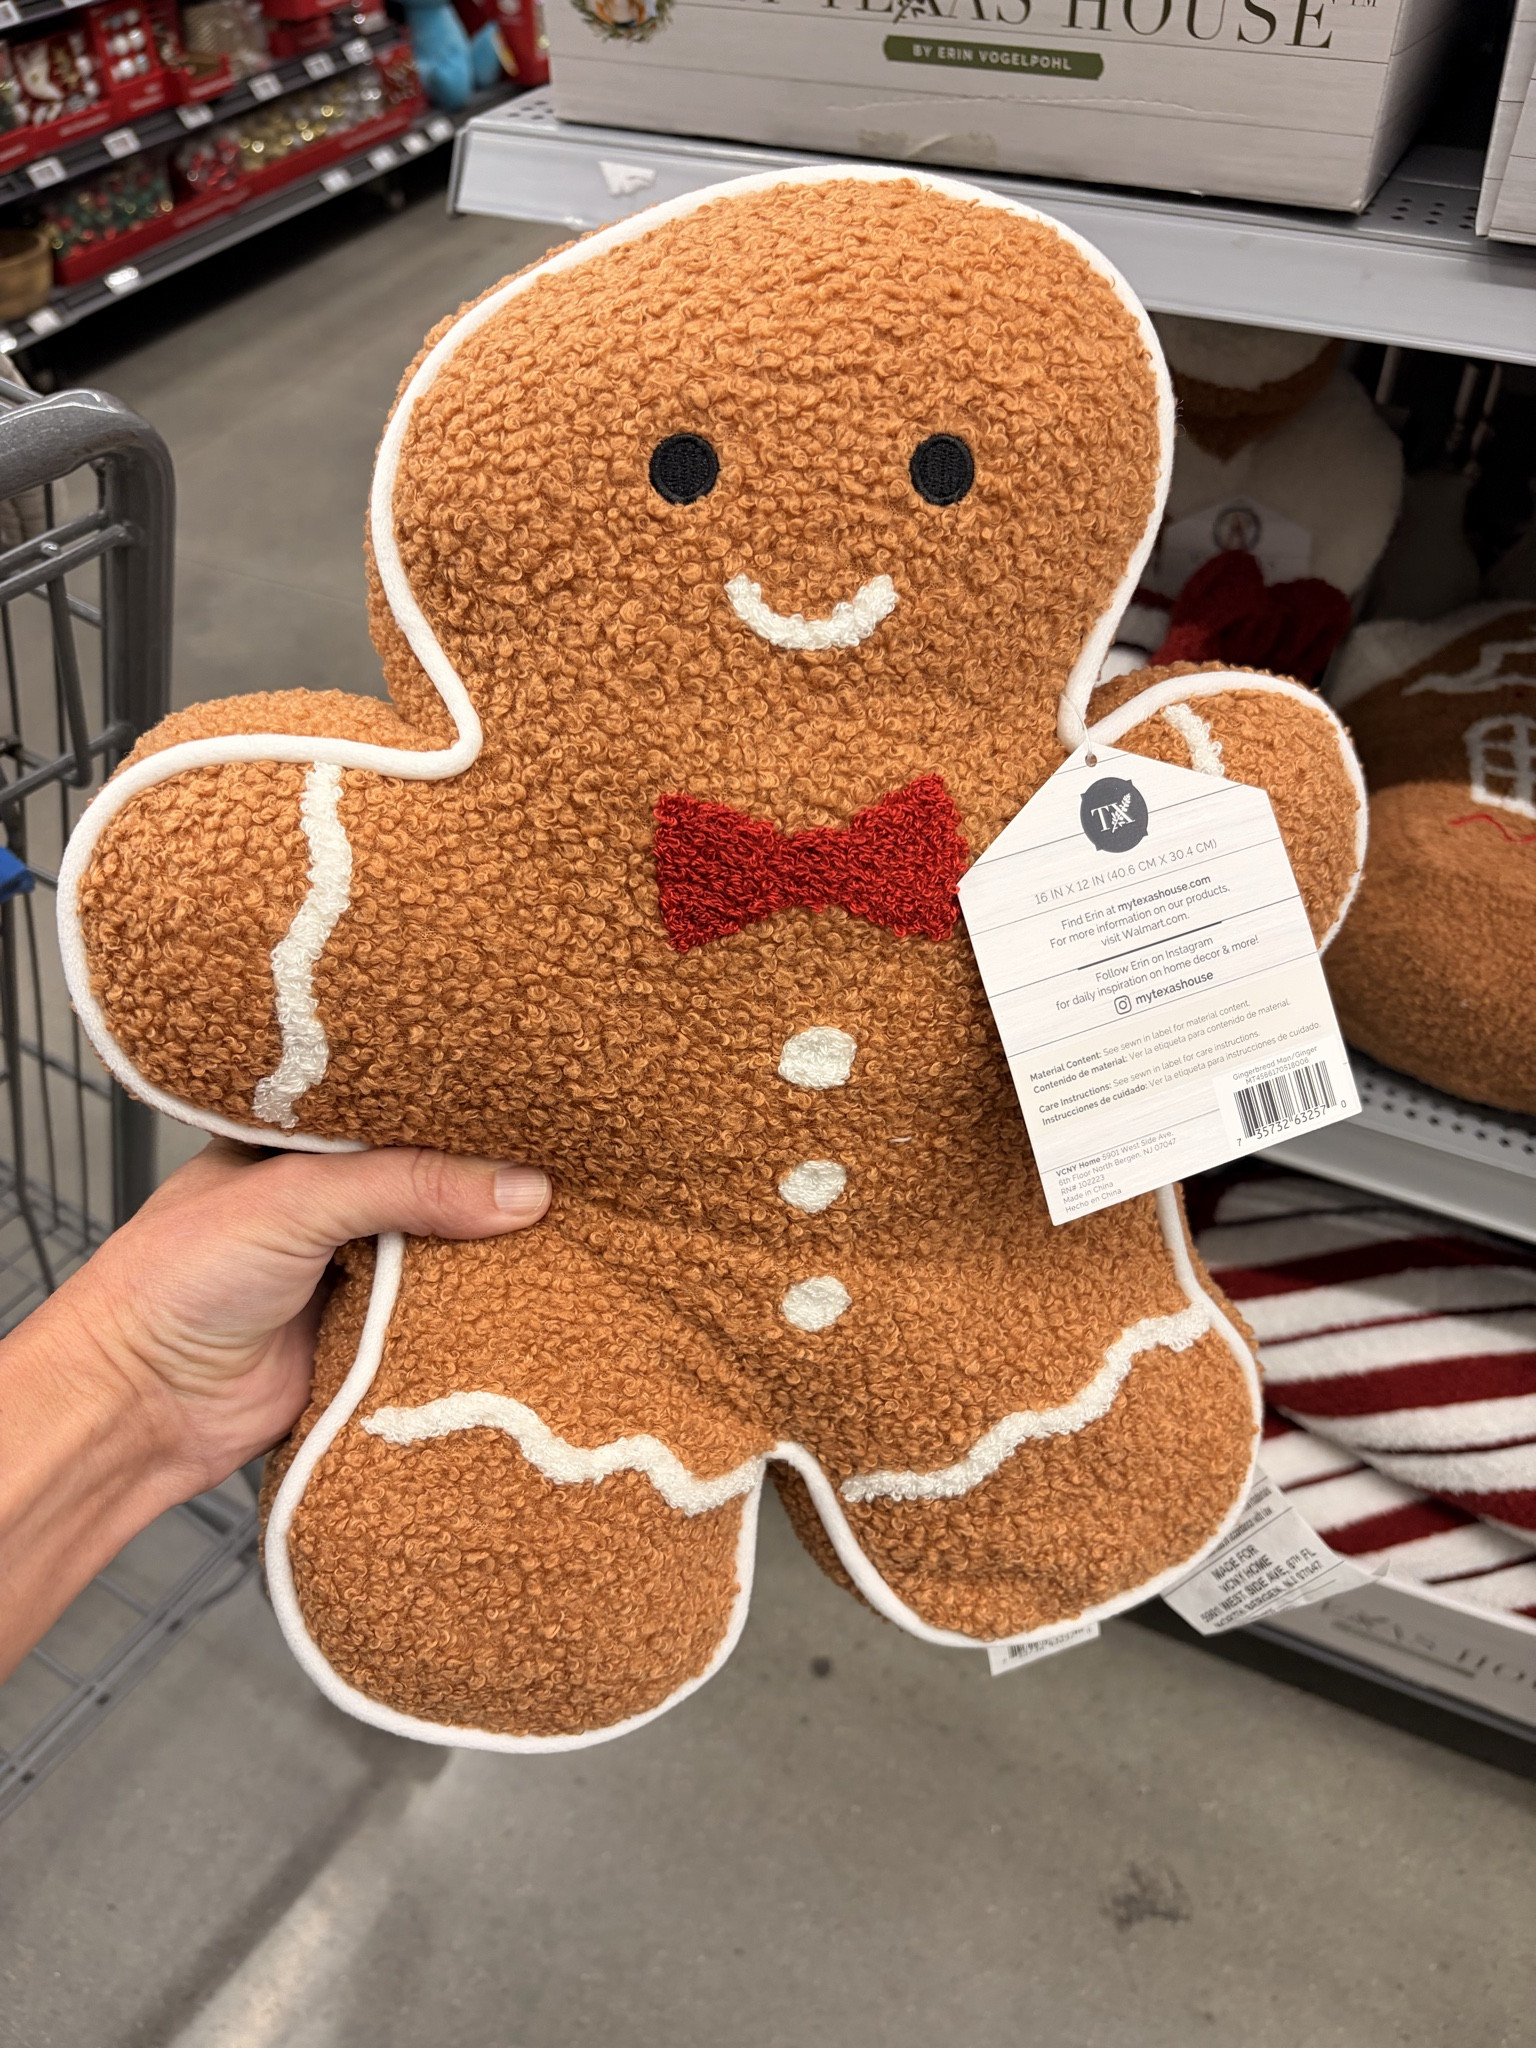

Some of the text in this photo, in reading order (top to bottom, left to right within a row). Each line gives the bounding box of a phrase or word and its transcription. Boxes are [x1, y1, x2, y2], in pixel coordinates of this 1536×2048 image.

[912, 44, 1072, 71] BY ERIN VOGELPOHL
[1035, 839, 1216, 904] 16 IN X 12 IN (40.6 CM X 30.4 CM)
[1049, 937, 1066, 948] For
[1068, 928, 1094, 942] more
[1096, 909, 1152, 933] information
[1153, 905, 1166, 914] on
[1167, 899, 1183, 910] our
[1061, 876, 1211, 929] Find Erin at mytexashouse.com
[1095, 937, 1213, 982] Follow Erin on Instagram
[1100, 933, 1121, 946] visit
[1056, 934, 1259, 1010] for daily inspiration on home decor & more!
[1135, 972, 1213, 1004] mytexashouse
[1029, 1063, 1065, 1082] Material
[1066, 1051, 1102, 1068] Content:
[1103, 1046, 1118, 1056] See
[1120, 1038, 1141, 1050] sewn
[1151, 1026, 1172, 1039] label
[1173, 1023, 1183, 1031] for
[1186, 1010, 1218, 1027] material
[1033, 1074, 1077, 1093] Contenido
[1078, 1069, 1089, 1078] de
[1090, 1055, 1127, 1074] material:
[1128, 1051, 1142, 1059] Ver
[1154, 1036, 1186, 1051] etiqueta
[1187, 1030, 1205, 1041] para
[1206, 1015, 1245, 1033] contenido
[1246, 1011, 1256, 1019] de
[1232, 1046, 1317, 1080] Gingerbread Man/Ginger
[1039, 1102, 1059, 1113] Care
[1060, 1083, 1112, 1106] Instructions:
[1113, 1077, 1128, 1087] See
[1130, 1069, 1151, 1081] sewn
[1161, 1057, 1182, 1069] label
[1183, 1053, 1193, 1062] for
[1196, 1047, 1213, 1057] care
[1042, 1101, 1098, 1125] Instrucciones
[1099, 1096, 1110, 1105] de
[1112, 1083, 1147, 1100] cuidado:
[1148, 1078, 1162, 1086] Ver
[1174, 1063, 1205, 1078] etiqueta
[1207, 1056, 1224, 1068] para
[1226, 1037, 1276, 1060] instrucciones
[1277, 1033, 1287, 1041] de
[1255, 1120, 1289, 1139] 35732
[1294, 1104, 1325, 1124] 63257
[1055, 1164, 1076, 1176] VCNY
[1078, 1157, 1100, 1168] Home
[1102, 1149, 1119, 1160] 5901
[1120, 1142, 1139, 1153] West
[1141, 1137, 1156, 1146] Side
[1058, 1177, 1071, 1186] 6th
[1072, 1170, 1090, 1181] Floor
[1092, 1162, 1113, 1173] North
[1143, 1146, 1152, 1155] NJ
[1154, 1137, 1176, 1151] 07047
[1061, 1174, 1104, 1195] RN# 102223
[1063, 1193, 1083, 1204] Made
[1093, 1182, 1113, 1193] China
[1065, 1200, 1089, 1213] Hecho
[1101, 1189, 1122, 1199] China
